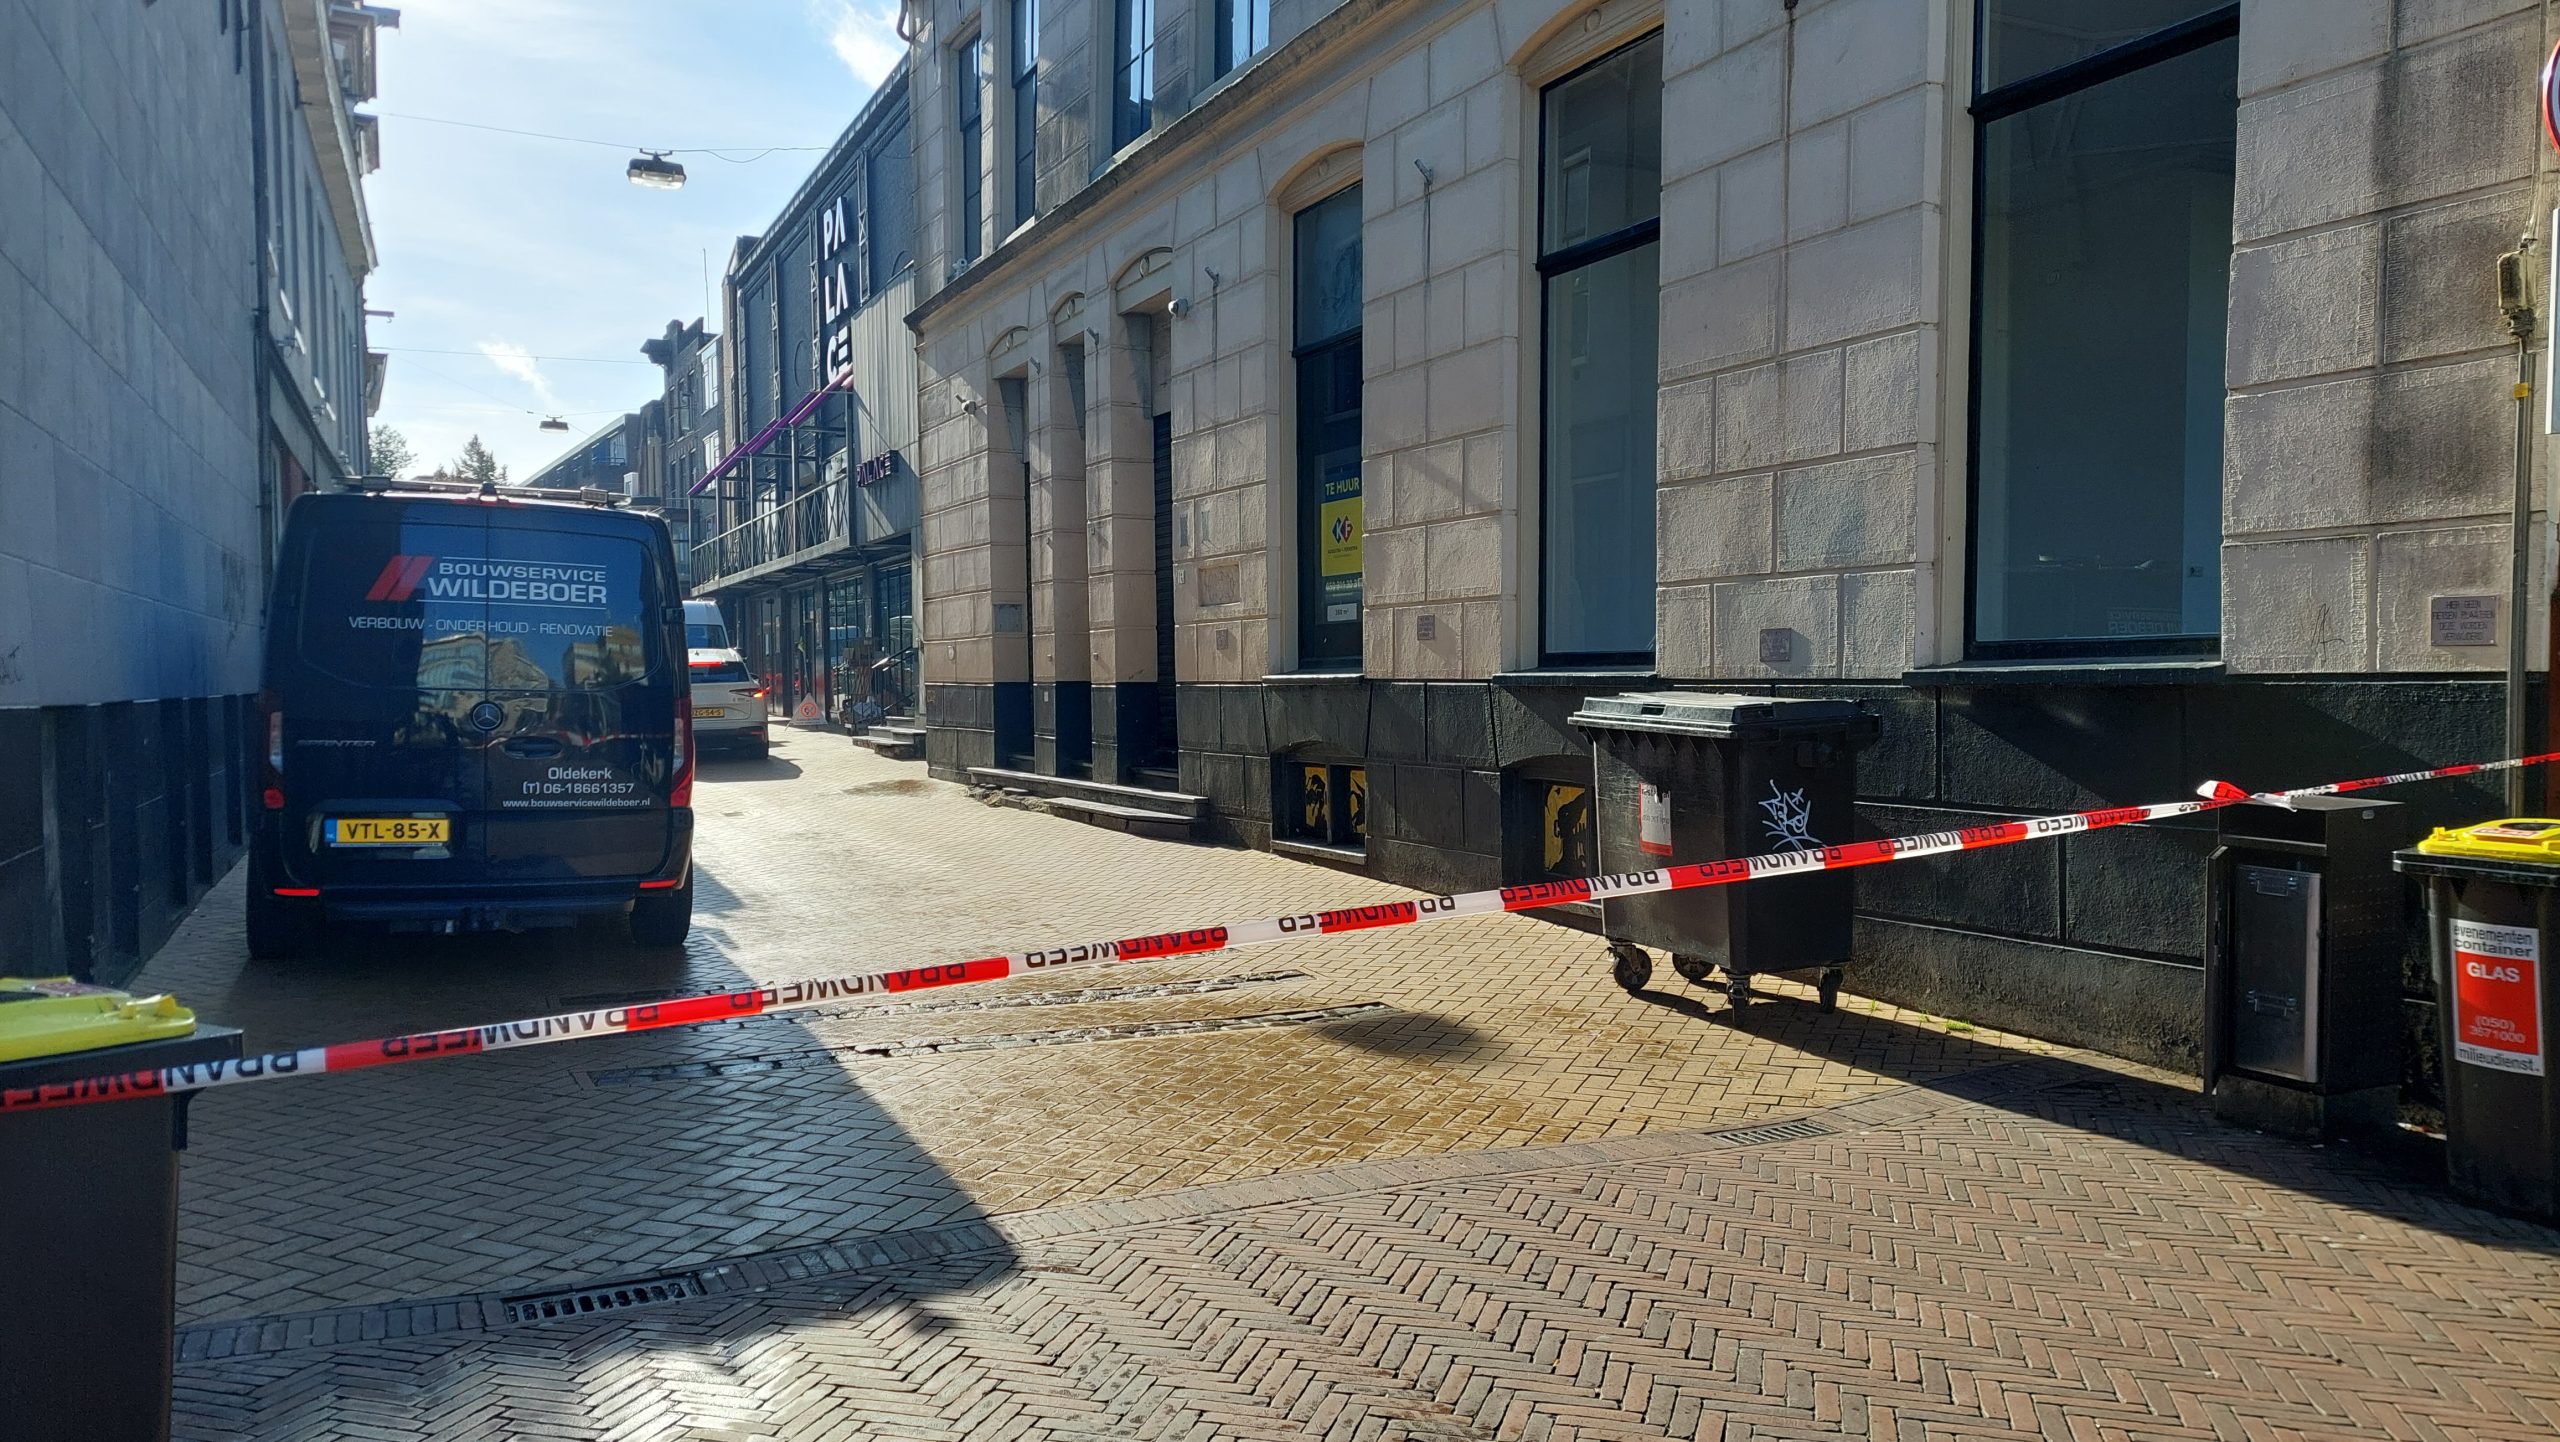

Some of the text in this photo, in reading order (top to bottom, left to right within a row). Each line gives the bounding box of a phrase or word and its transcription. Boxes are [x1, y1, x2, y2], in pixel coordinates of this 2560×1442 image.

[1325, 477, 1361, 496] TE HUUR
[438, 562, 607, 583] BOUWSERVICE
[427, 577, 607, 604] WILDEBOER
[348, 616, 425, 630] VERBOUW
[436, 619, 529, 634] ONDERHOUD
[540, 623, 614, 637] RENOVATIE
[547, 767, 613, 780] Oldekerk
[523, 781, 635, 795] (T) 06-18661357
[502, 798, 651, 808] www.bouwservicewildeboer.nl
[346, 822, 441, 840] VTL-85-X
[2454, 924, 2533, 945] evenementen
[2454, 938, 2533, 958] container
[2466, 962, 2521, 983] GLAS
